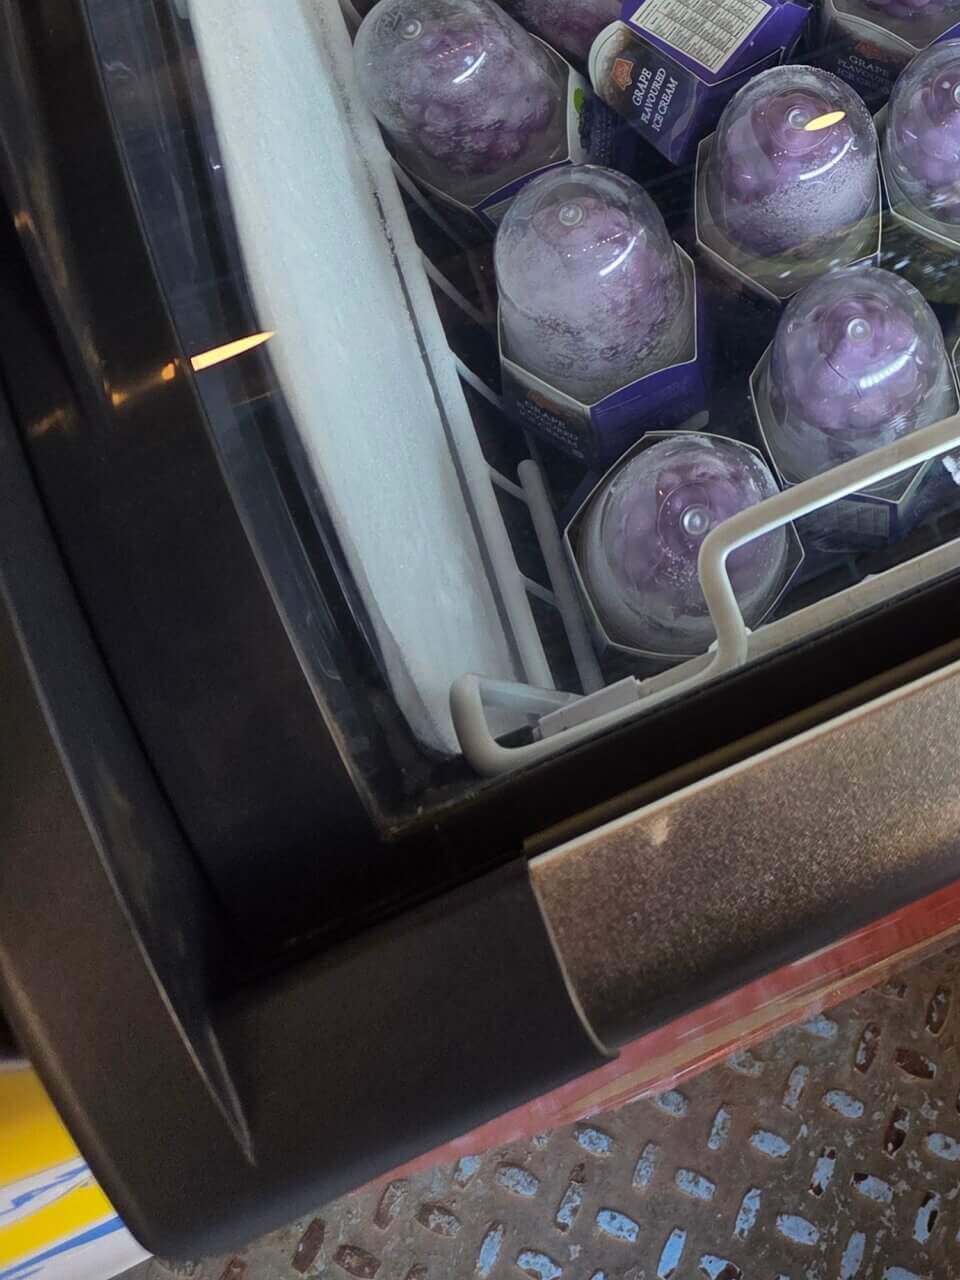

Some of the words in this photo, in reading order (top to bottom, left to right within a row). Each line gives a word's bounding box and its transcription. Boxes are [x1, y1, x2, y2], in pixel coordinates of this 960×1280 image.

[632, 67, 653, 106] GRAPE
[641, 67, 666, 124] FLAVOURED
[651, 113, 664, 132] ICE
[658, 76, 678, 115] CREAM
